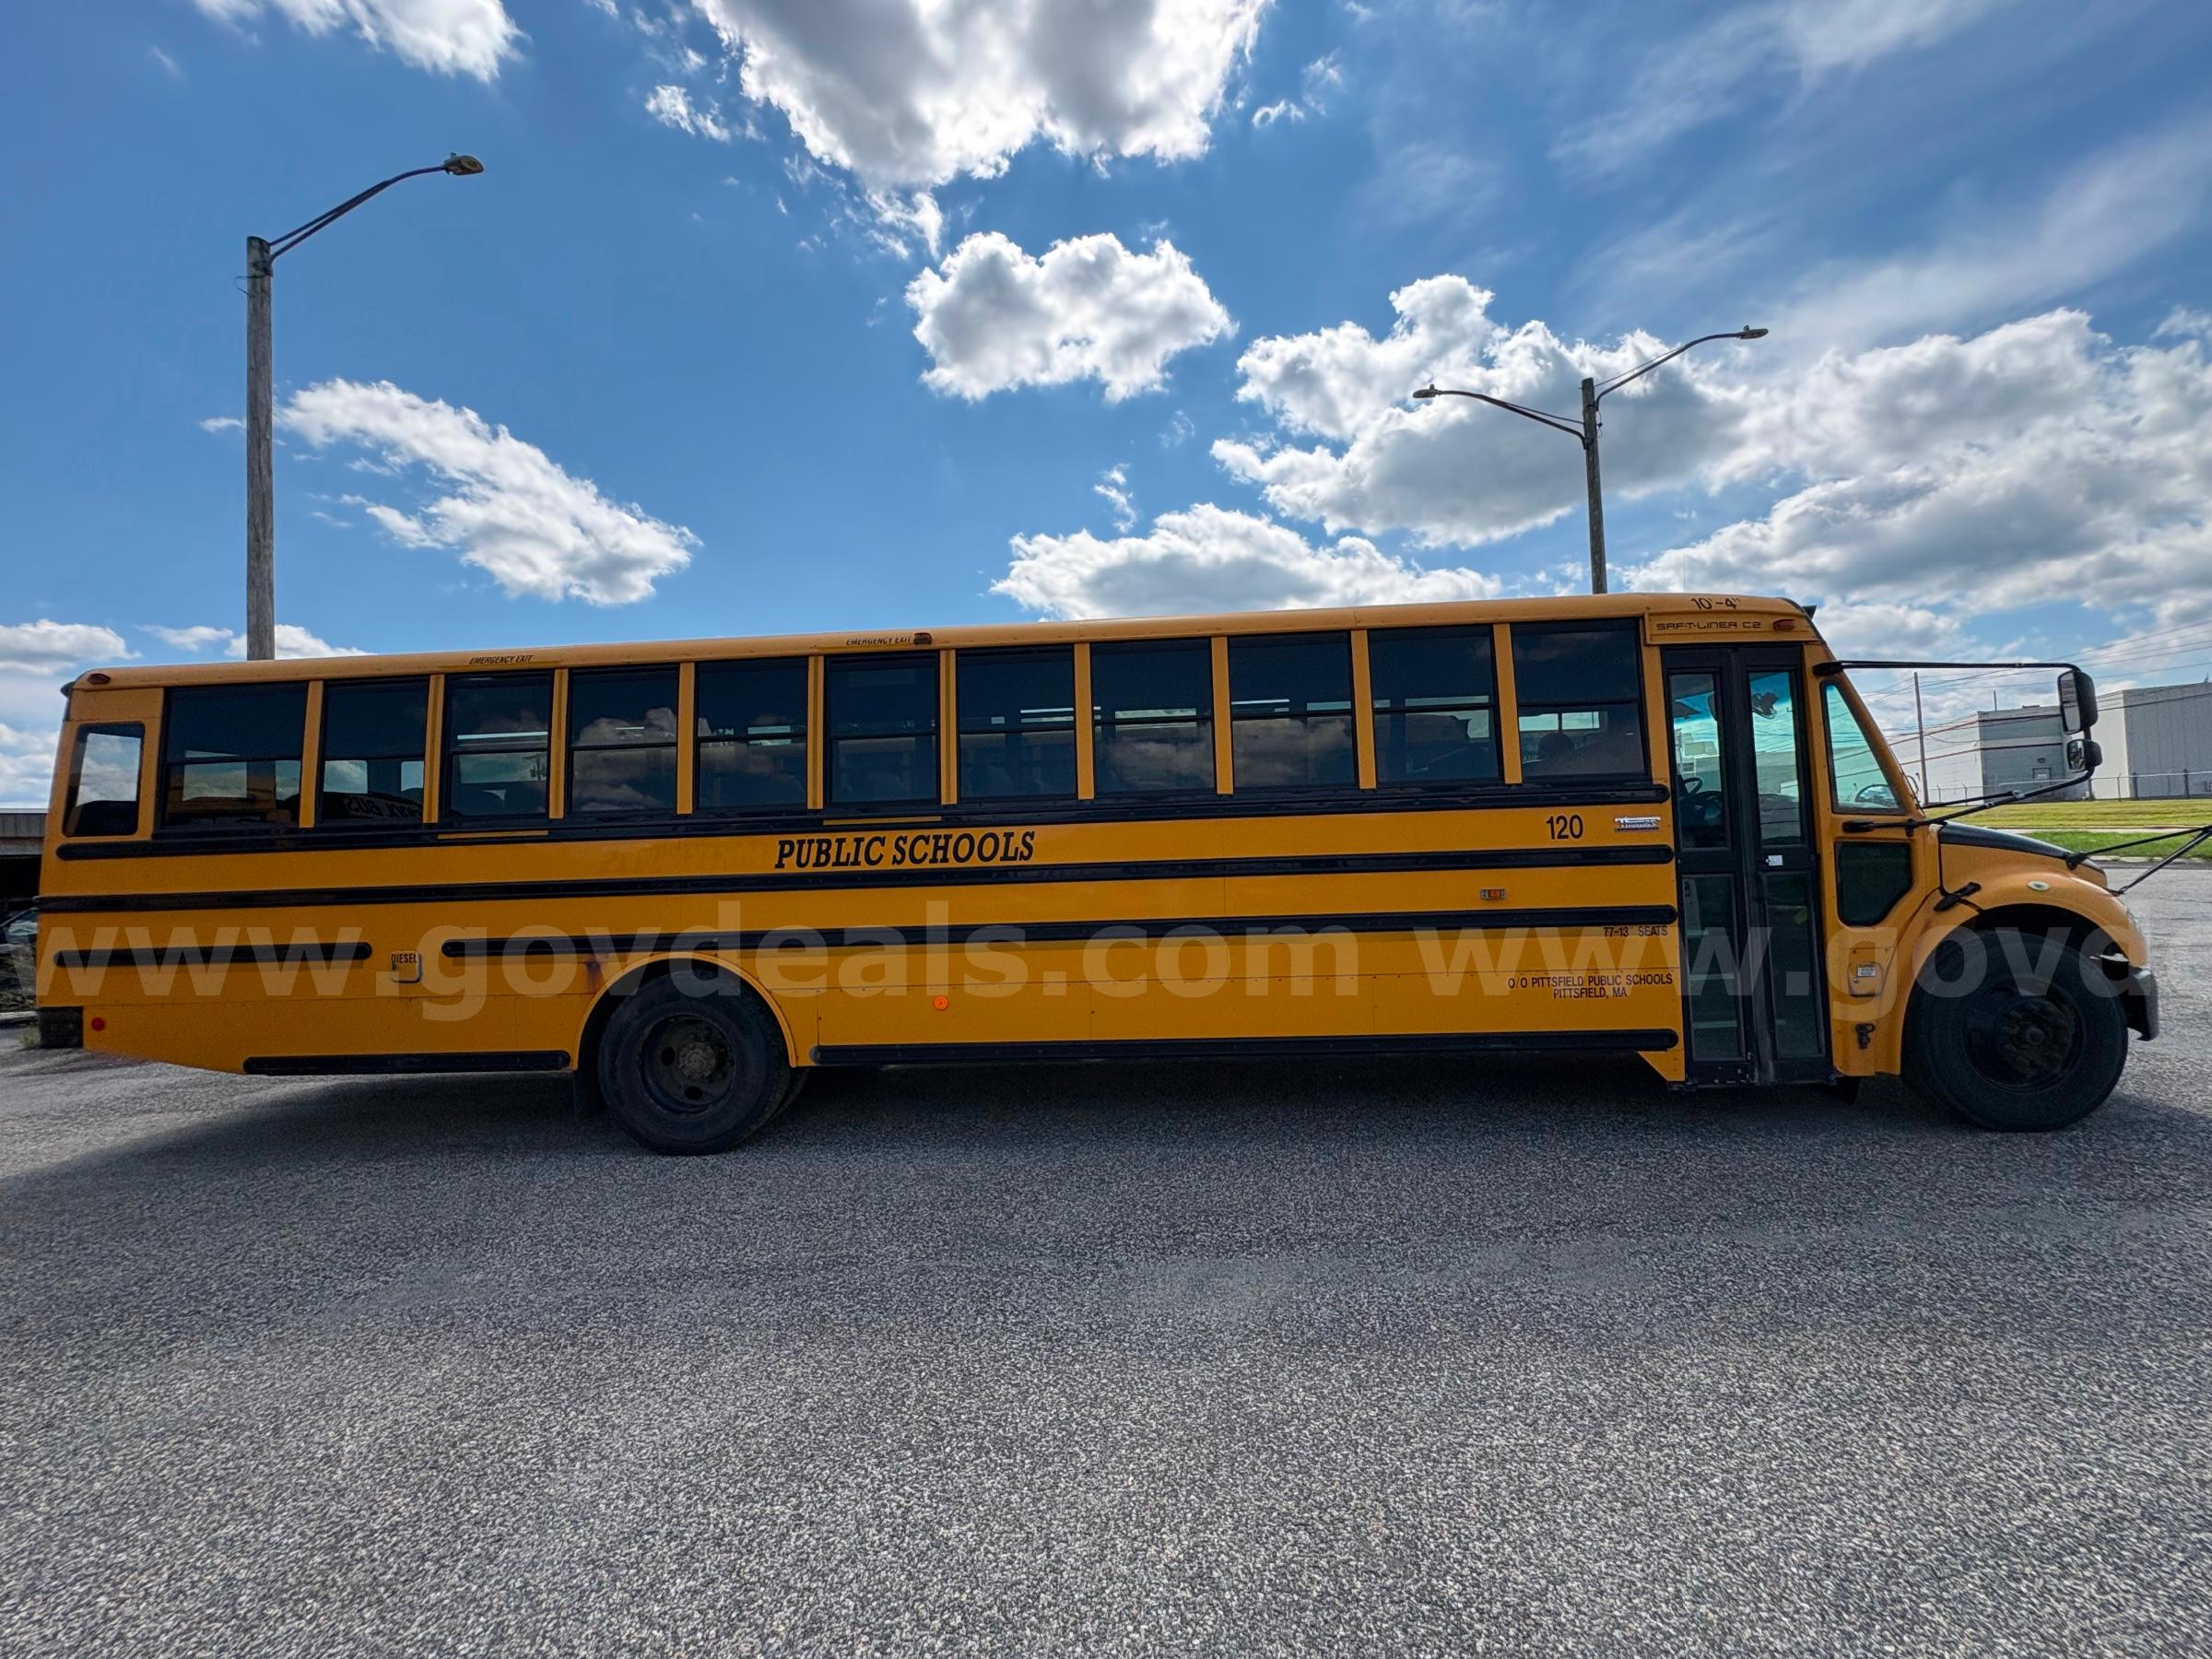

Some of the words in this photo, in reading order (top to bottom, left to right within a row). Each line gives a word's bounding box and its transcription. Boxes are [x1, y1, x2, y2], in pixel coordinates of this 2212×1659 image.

[1742, 621, 1761, 629] C2
[846, 637, 893, 646] EMERGENCY
[894, 636, 912, 644] EXIT
[468, 655, 515, 665] EMERGENCY
[515, 654, 535, 664] EXIT
[1546, 814, 1584, 840] 120
[774, 836, 887, 869] PUBLIC
[891, 830, 1036, 865] SCHOOLS
[1638, 924, 1668, 937] SEATS
[391, 953, 418, 964] DIESEL
[1531, 975, 1584, 988] PITTSFIELD
[1587, 974, 1622, 987] PUBLIC
[1625, 972, 1674, 985] SCHOOLS
[1553, 986, 1609, 999] PITTSFIELD,
[1612, 986, 1628, 997] MA
